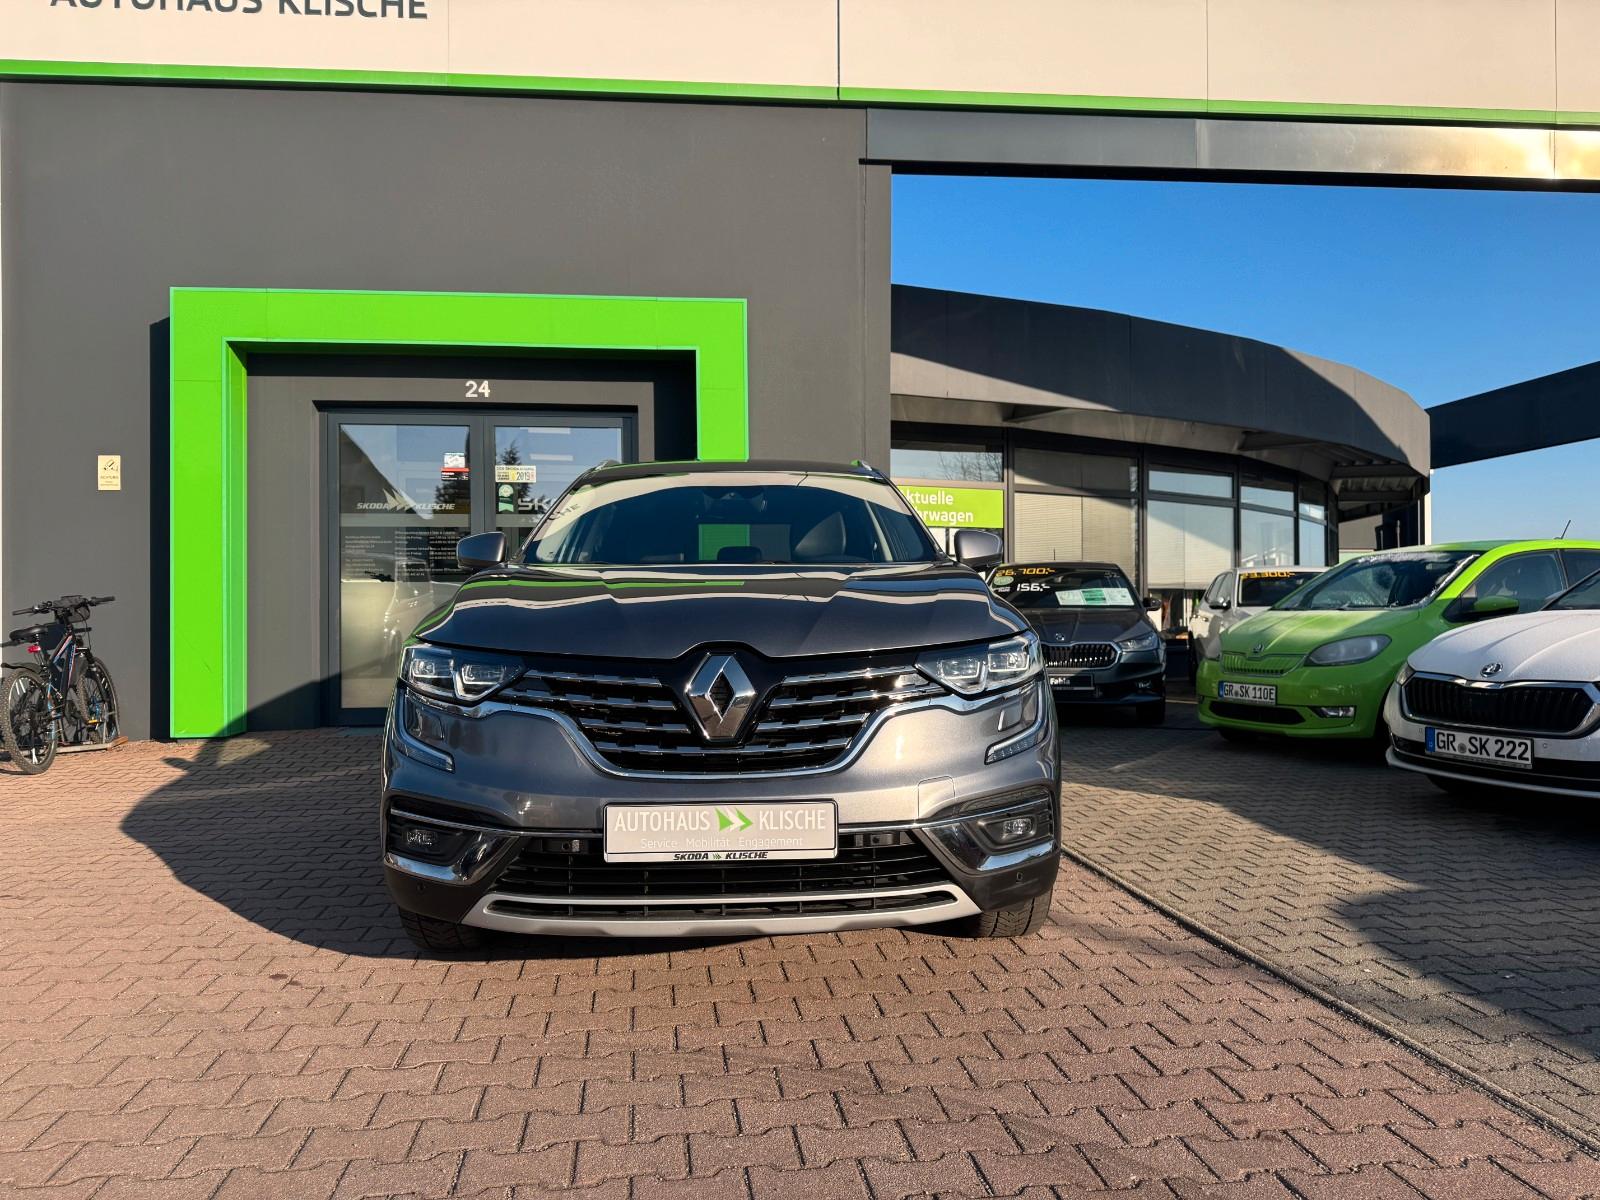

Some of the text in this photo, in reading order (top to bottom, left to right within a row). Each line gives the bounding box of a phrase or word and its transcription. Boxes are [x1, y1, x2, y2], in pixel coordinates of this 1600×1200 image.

[465, 380, 490, 398] 24
[903, 489, 954, 505] ktuelle
[1224, 683, 1275, 701] GR SK 110E
[1436, 731, 1457, 752] GR
[1468, 736, 1491, 757] SK
[1494, 738, 1530, 762] 222
[614, 808, 827, 833] AUTOHAUS KLISCHE
[685, 836, 730, 849] Mobilität
[738, 836, 804, 850] Engagement
[673, 851, 769, 861] SKODA KLISCHE
